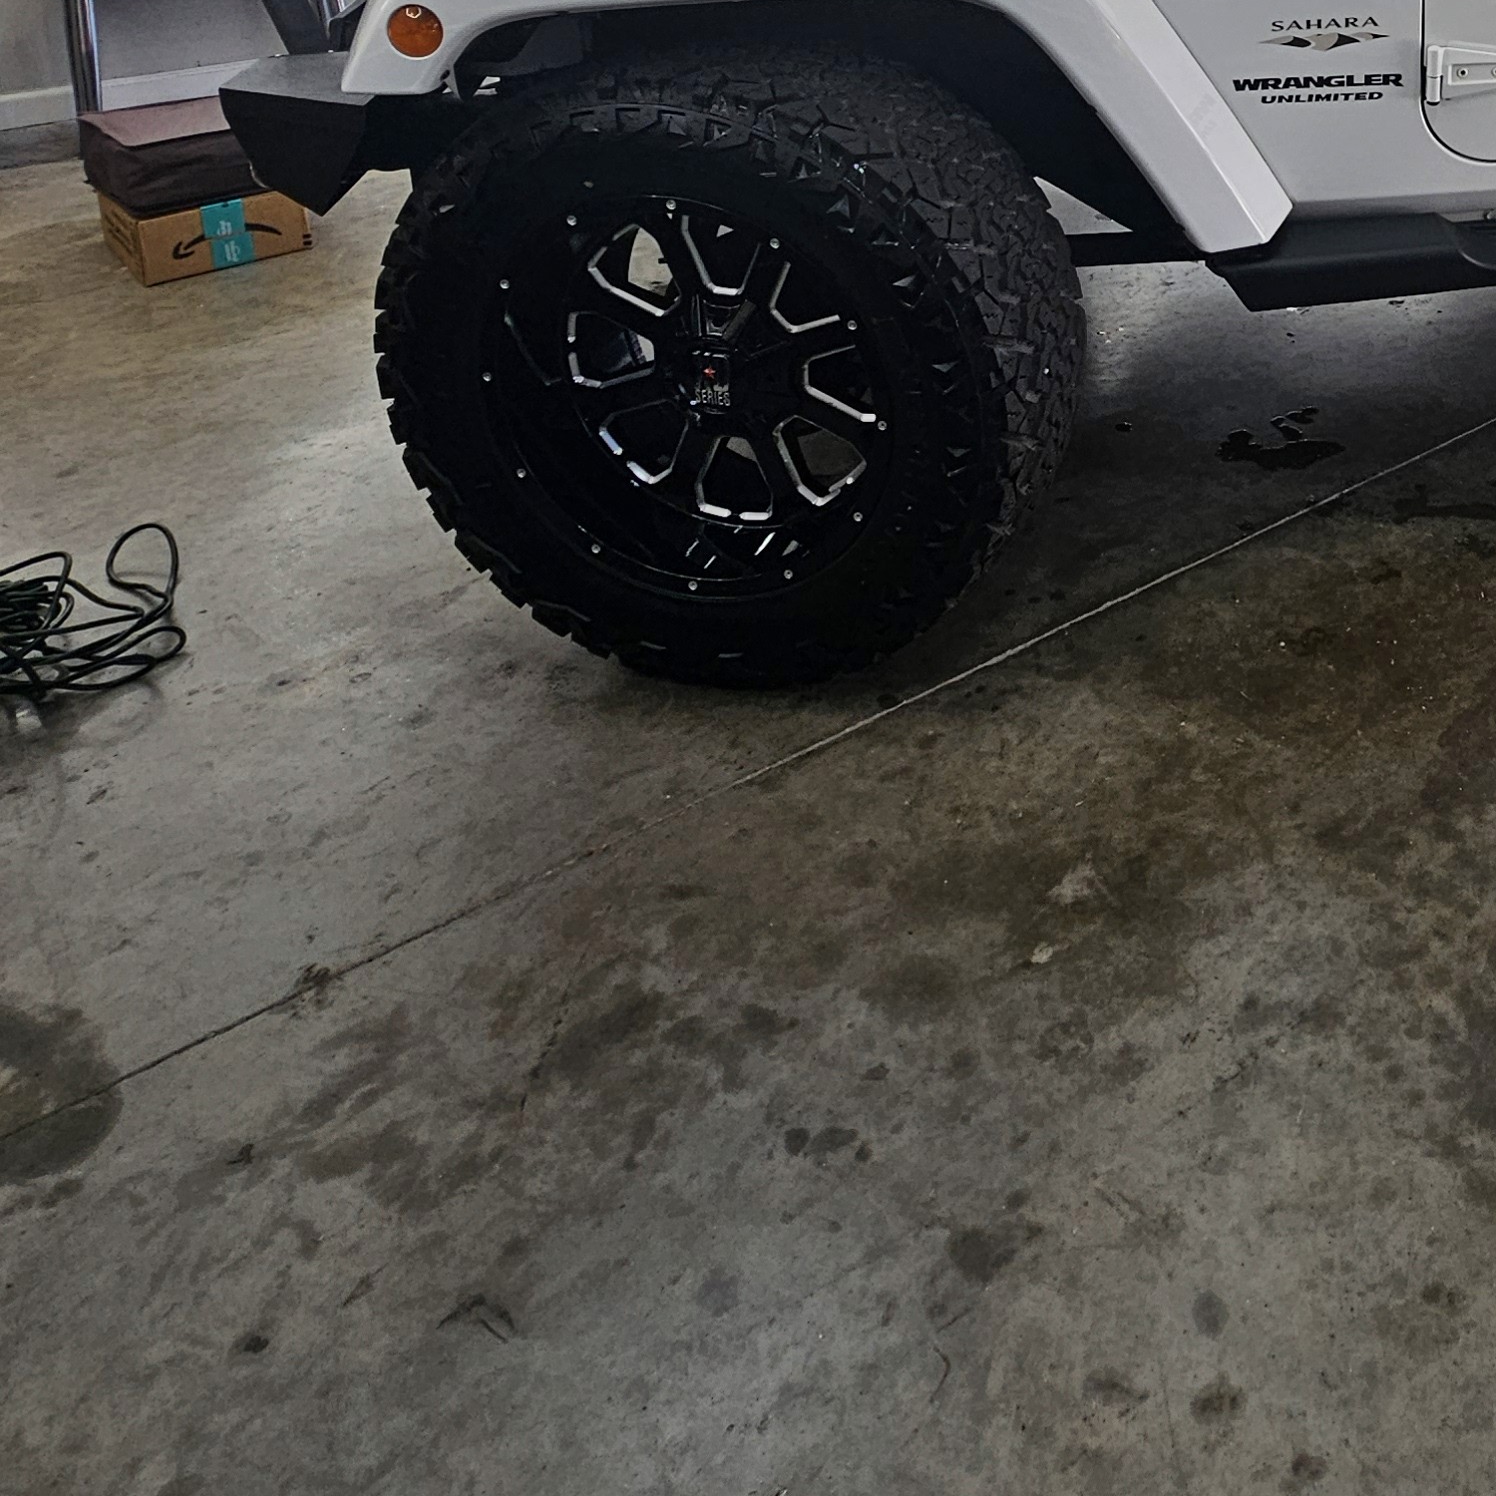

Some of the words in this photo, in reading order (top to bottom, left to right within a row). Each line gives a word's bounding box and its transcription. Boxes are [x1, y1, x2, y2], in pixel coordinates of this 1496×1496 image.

[1271, 16, 1379, 32] SAHARA
[1232, 73, 1404, 92] WRANGLER
[1261, 91, 1384, 104] UNLIMITED
[694, 388, 731, 406] SERIES
